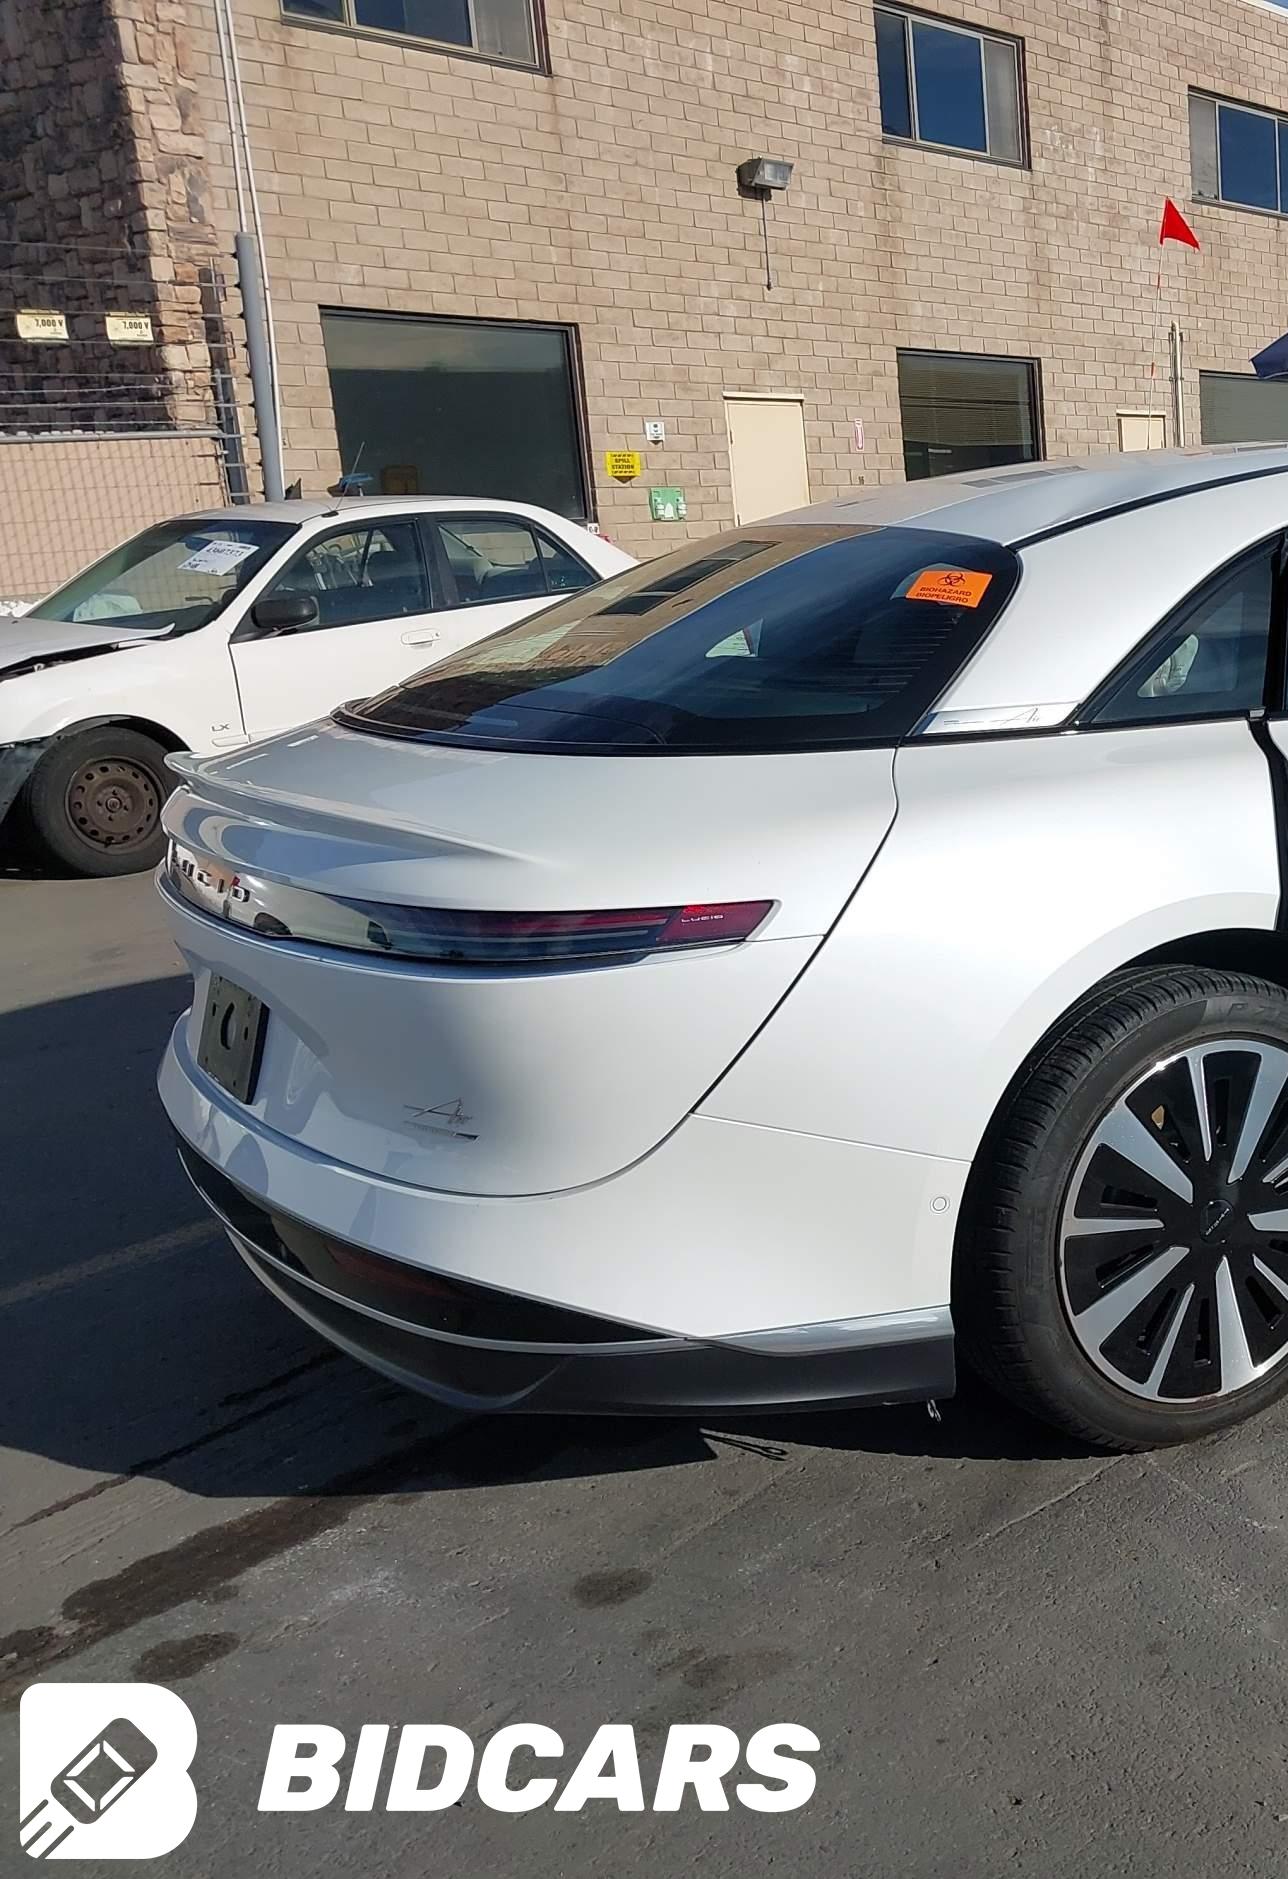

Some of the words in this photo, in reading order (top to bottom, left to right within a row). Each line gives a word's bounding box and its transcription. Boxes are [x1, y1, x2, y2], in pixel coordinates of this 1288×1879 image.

[34, 318, 57, 328] 7,000
[58, 319, 64, 327] V
[143, 321, 149, 329] V
[919, 586, 972, 597] BIOHAZARD
[916, 592, 969, 603] BIOPELIGRO
[211, 723, 230, 732] LX
